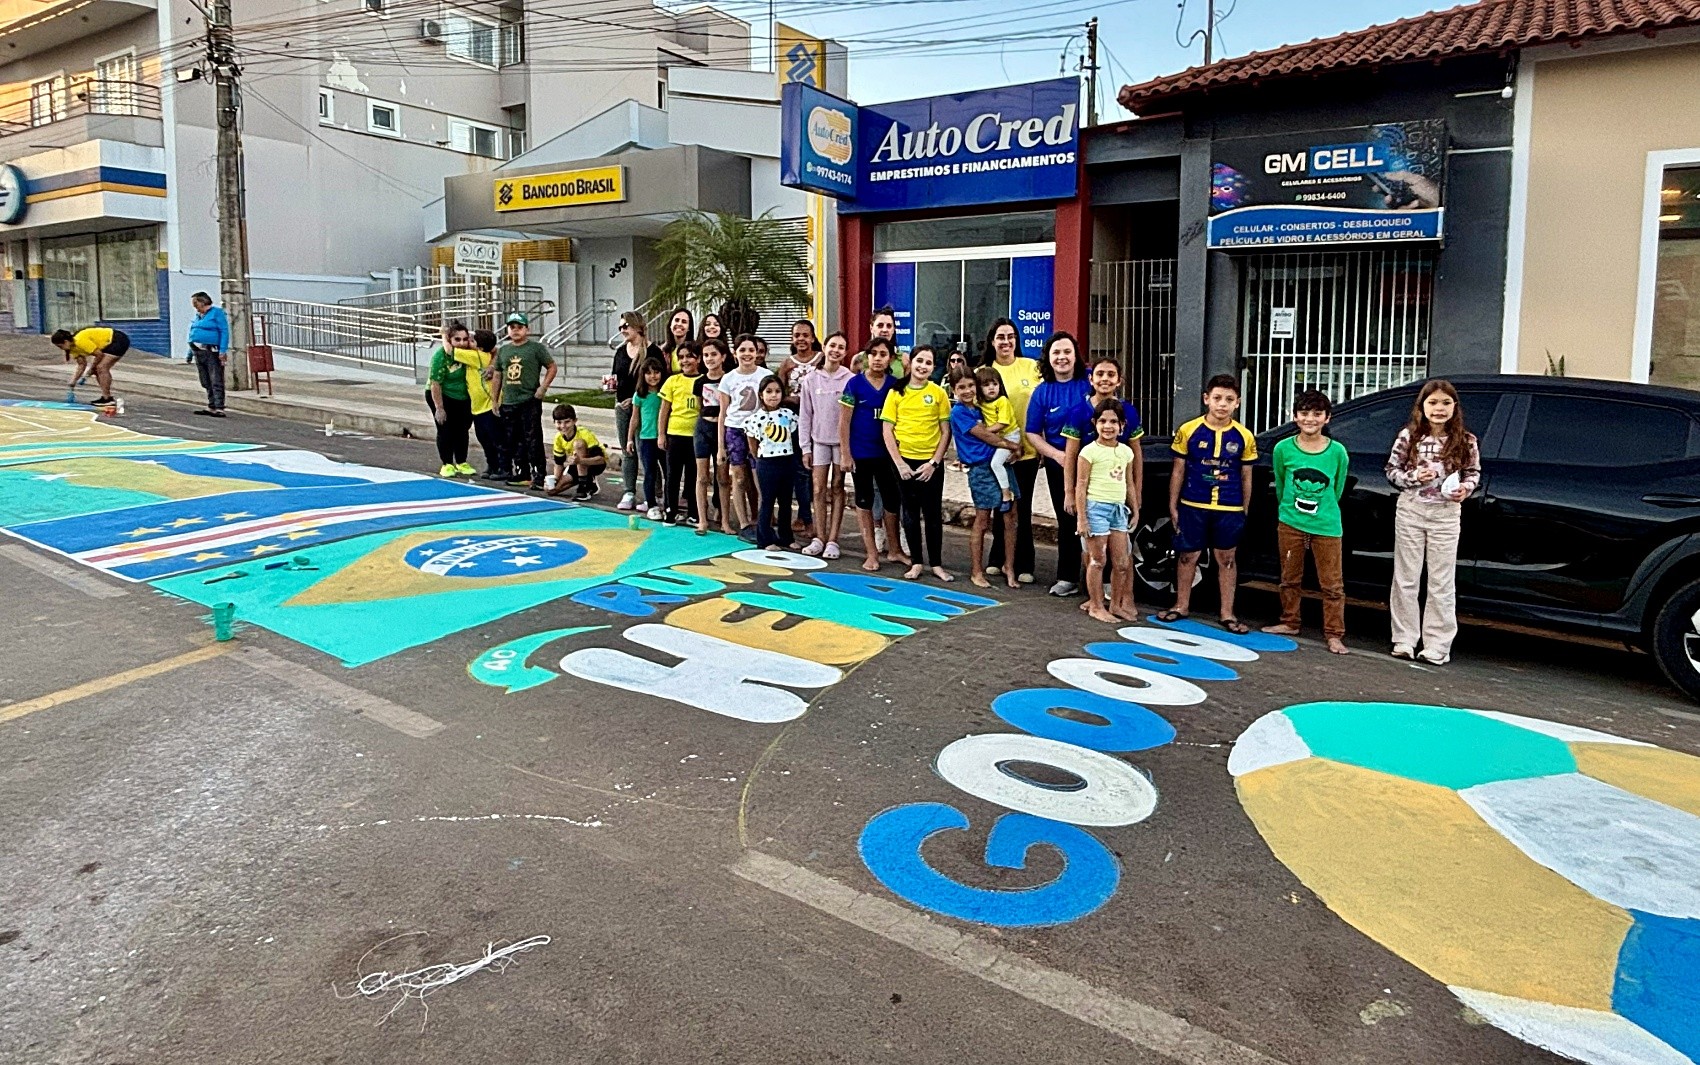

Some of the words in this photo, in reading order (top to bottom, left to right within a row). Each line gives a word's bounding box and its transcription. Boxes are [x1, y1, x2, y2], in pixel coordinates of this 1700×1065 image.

[813, 121, 848, 146] AutoCred
[870, 103, 1077, 163] AutoCred
[870, 164, 951, 182] EMPRESTIMOS
[953, 163, 960, 174] E
[961, 152, 1076, 173] FINANCIAMENTOS
[1264, 152, 1306, 174] GM
[1313, 147, 1384, 171] CELL
[816, 166, 852, 185] 99743-0174
[1281, 179, 1317, 187] CELULARES
[522, 184, 559, 200] BANCO
[560, 182, 575, 197] DO
[576, 178, 615, 195] BRASIL
[1233, 223, 1274, 234] CELULAR
[1280, 221, 1336, 232] CONSERTOS
[1343, 217, 1412, 229] DESBLOQUEIO
[1219, 235, 1261, 246] PELÍCULA
[1262, 235, 1275, 244] DE
[1276, 234, 1304, 243] VIDRO
[1306, 234, 1313, 242] E
[1313, 230, 1375, 242] ACESSÓRIOS
[1376, 230, 1391, 240] EM
[1391, 228, 1426, 239] GERAL
[609, 257, 628, 279] 350
[1018, 309, 1051, 322] Saque
[1023, 325, 1045, 336] aqui
[1024, 339, 1043, 348] seu
[686, 397, 695, 409] 10
[570, 549, 828, 617] RUMO
[482, 649, 518, 671] AO
[559, 572, 1004, 723] HEXA
